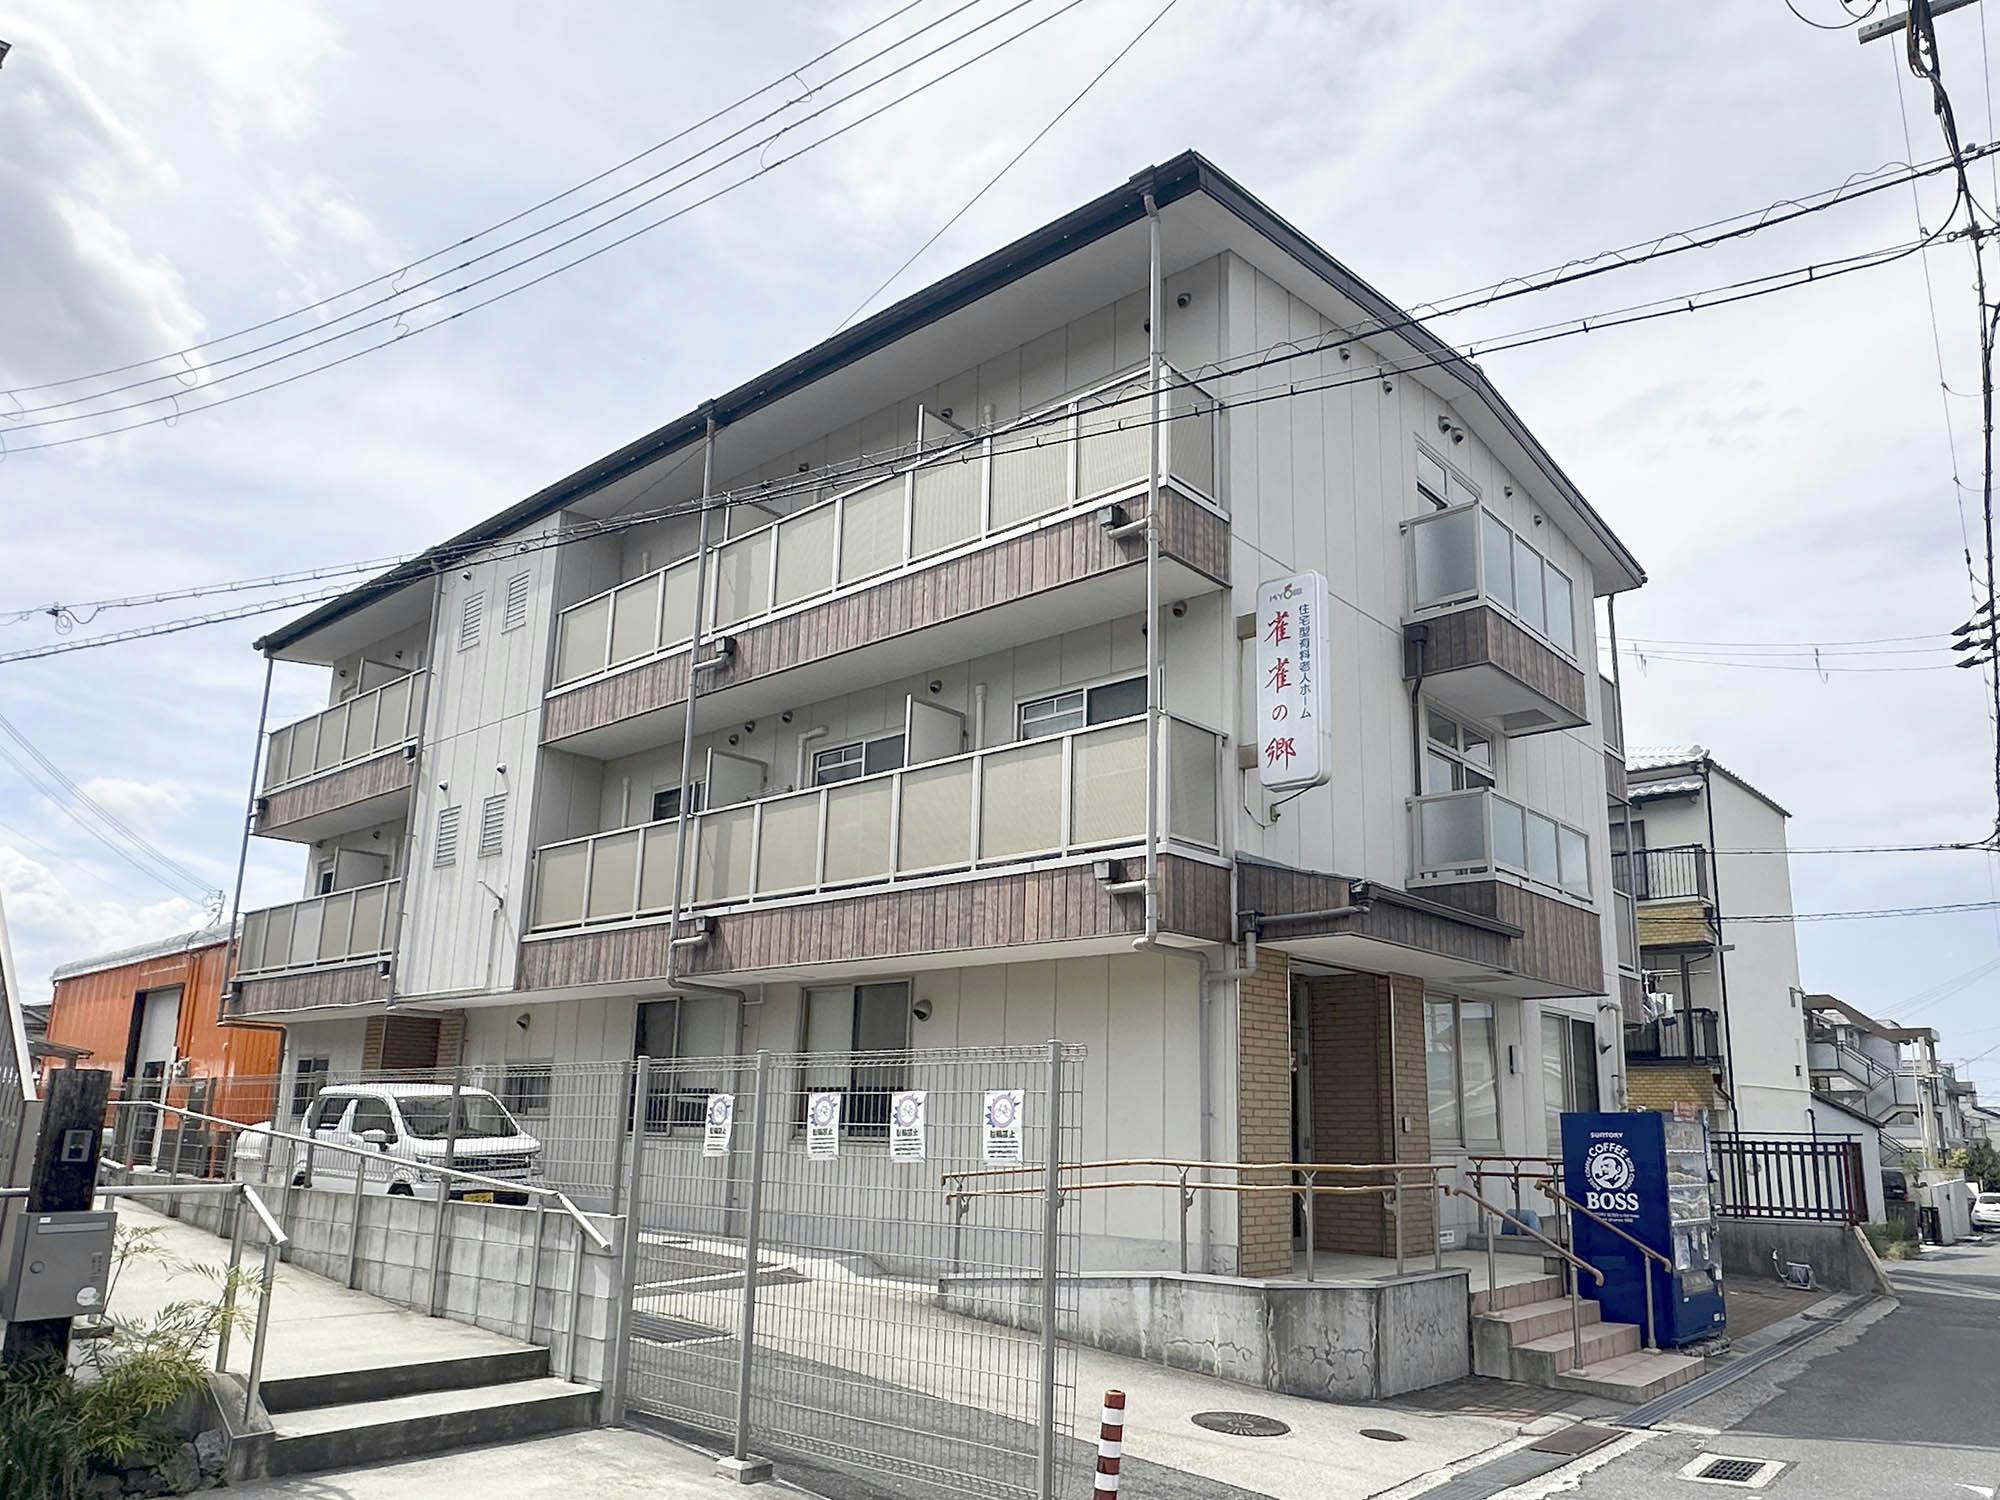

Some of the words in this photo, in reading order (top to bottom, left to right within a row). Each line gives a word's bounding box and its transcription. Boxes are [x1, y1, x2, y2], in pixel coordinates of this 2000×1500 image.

[1264, 611, 1296, 770] 雀雀の郷
[1299, 604, 1311, 719] 住宅型有料老人ホーム
[1589, 1143, 1628, 1157] COFFEE
[1586, 1192, 1639, 1211] BOSS
